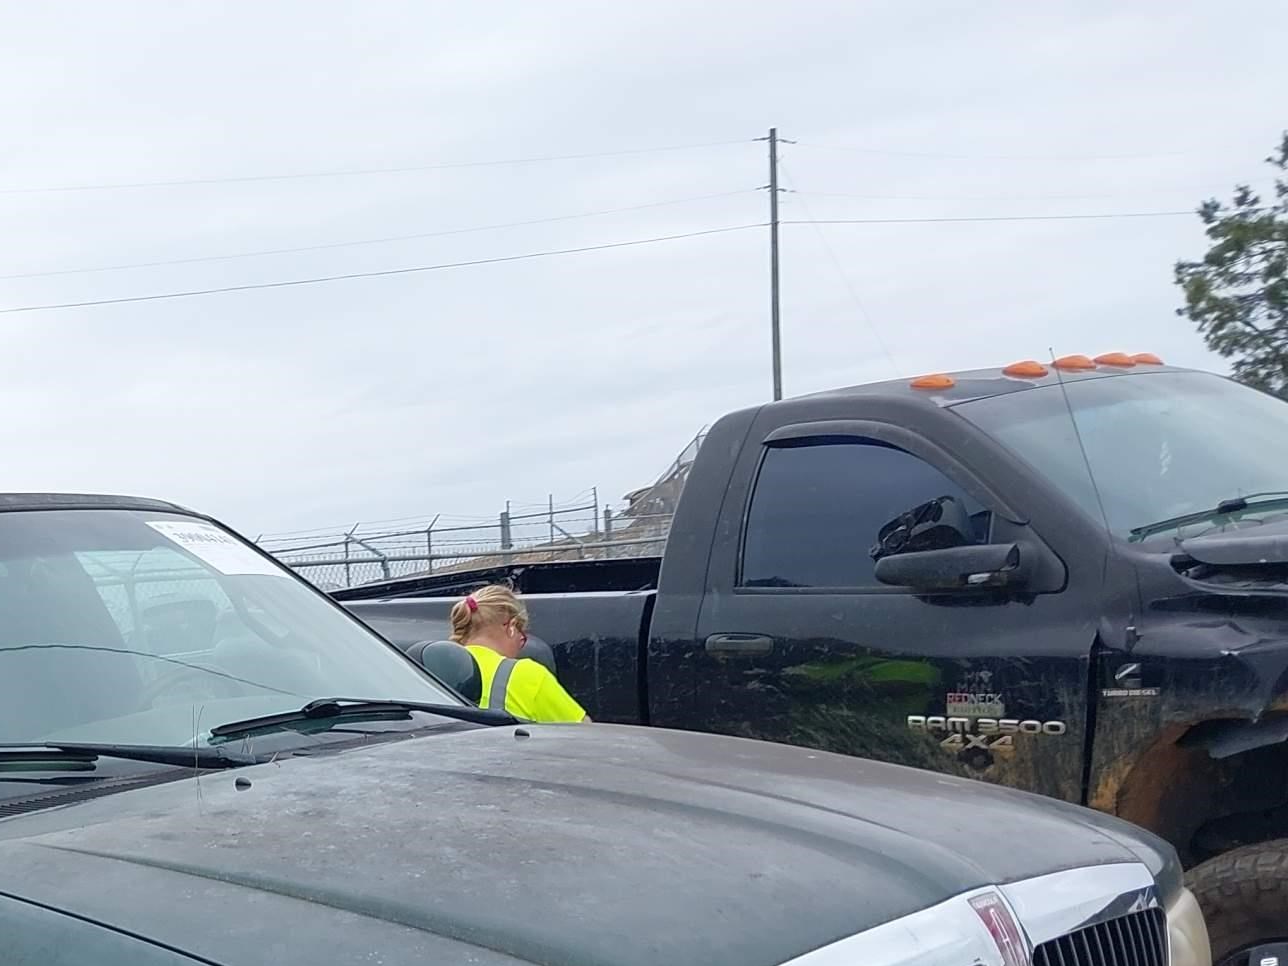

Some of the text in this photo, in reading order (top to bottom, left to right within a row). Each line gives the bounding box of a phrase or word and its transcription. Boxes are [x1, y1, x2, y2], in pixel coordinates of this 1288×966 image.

[946, 692, 1002, 705] REDNECK
[907, 715, 1066, 735] RAM 3500
